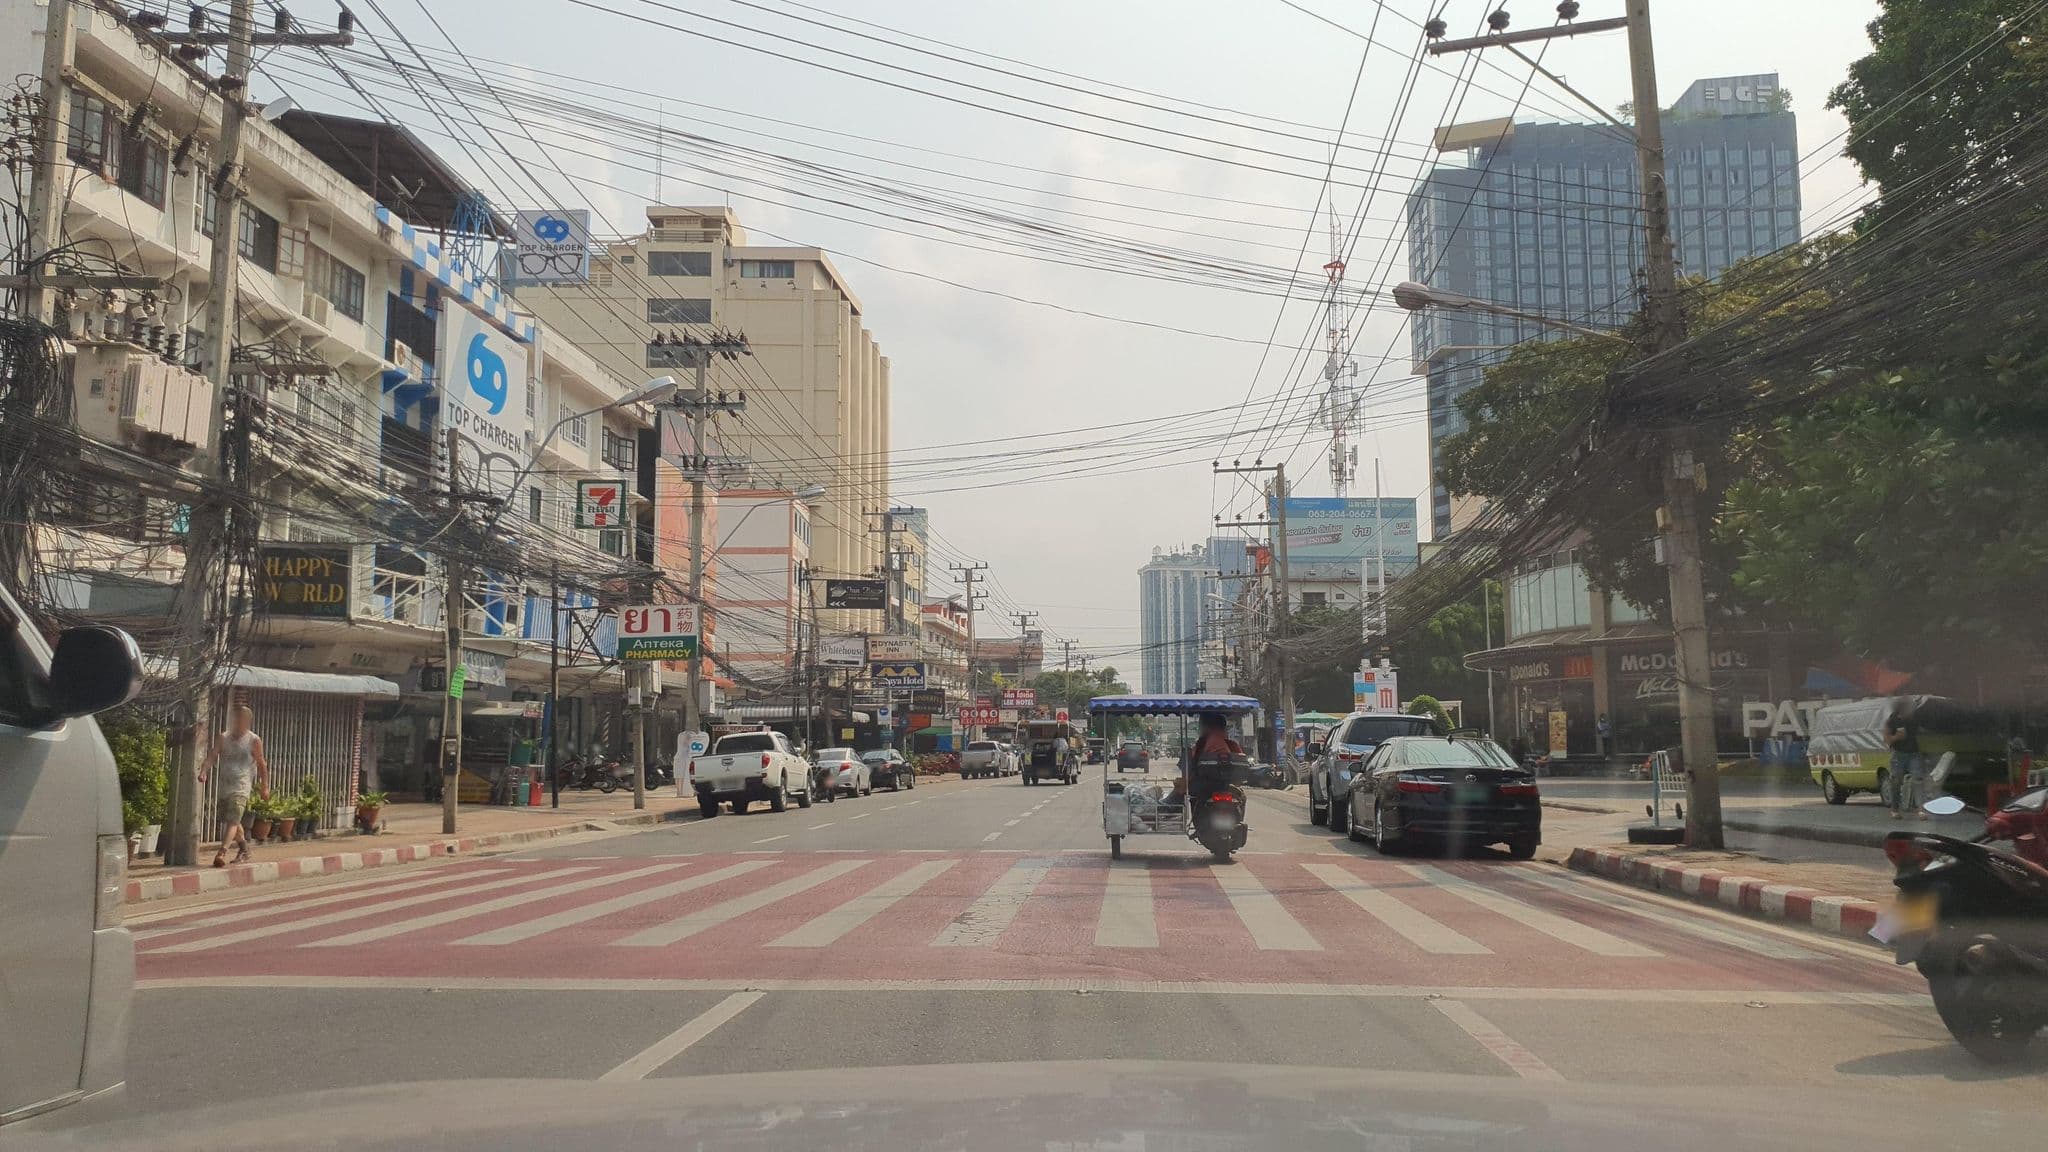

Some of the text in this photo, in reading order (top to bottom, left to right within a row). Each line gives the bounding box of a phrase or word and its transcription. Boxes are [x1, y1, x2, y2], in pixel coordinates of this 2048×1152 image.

[1705, 85, 1772, 103] EDGE
[520, 244, 583, 252] TOP CHAROEN
[449, 402, 521, 453] TOP CHAROEN
[588, 487, 616, 527] 7
[1308, 510, 1379, 518] 063-204-0667-
[266, 557, 334, 577] HAPPY
[624, 608, 671, 634] ยา
[676, 607, 693, 634] 药物
[632, 639, 684, 649] Аптека
[821, 643, 864, 656] Whitehouse
[625, 648, 692, 659] PHARMACY
[1620, 652, 1749, 672] McDold's
[903, 676, 924, 686] Hotel
[1015, 698, 1034, 706] HOTEL
